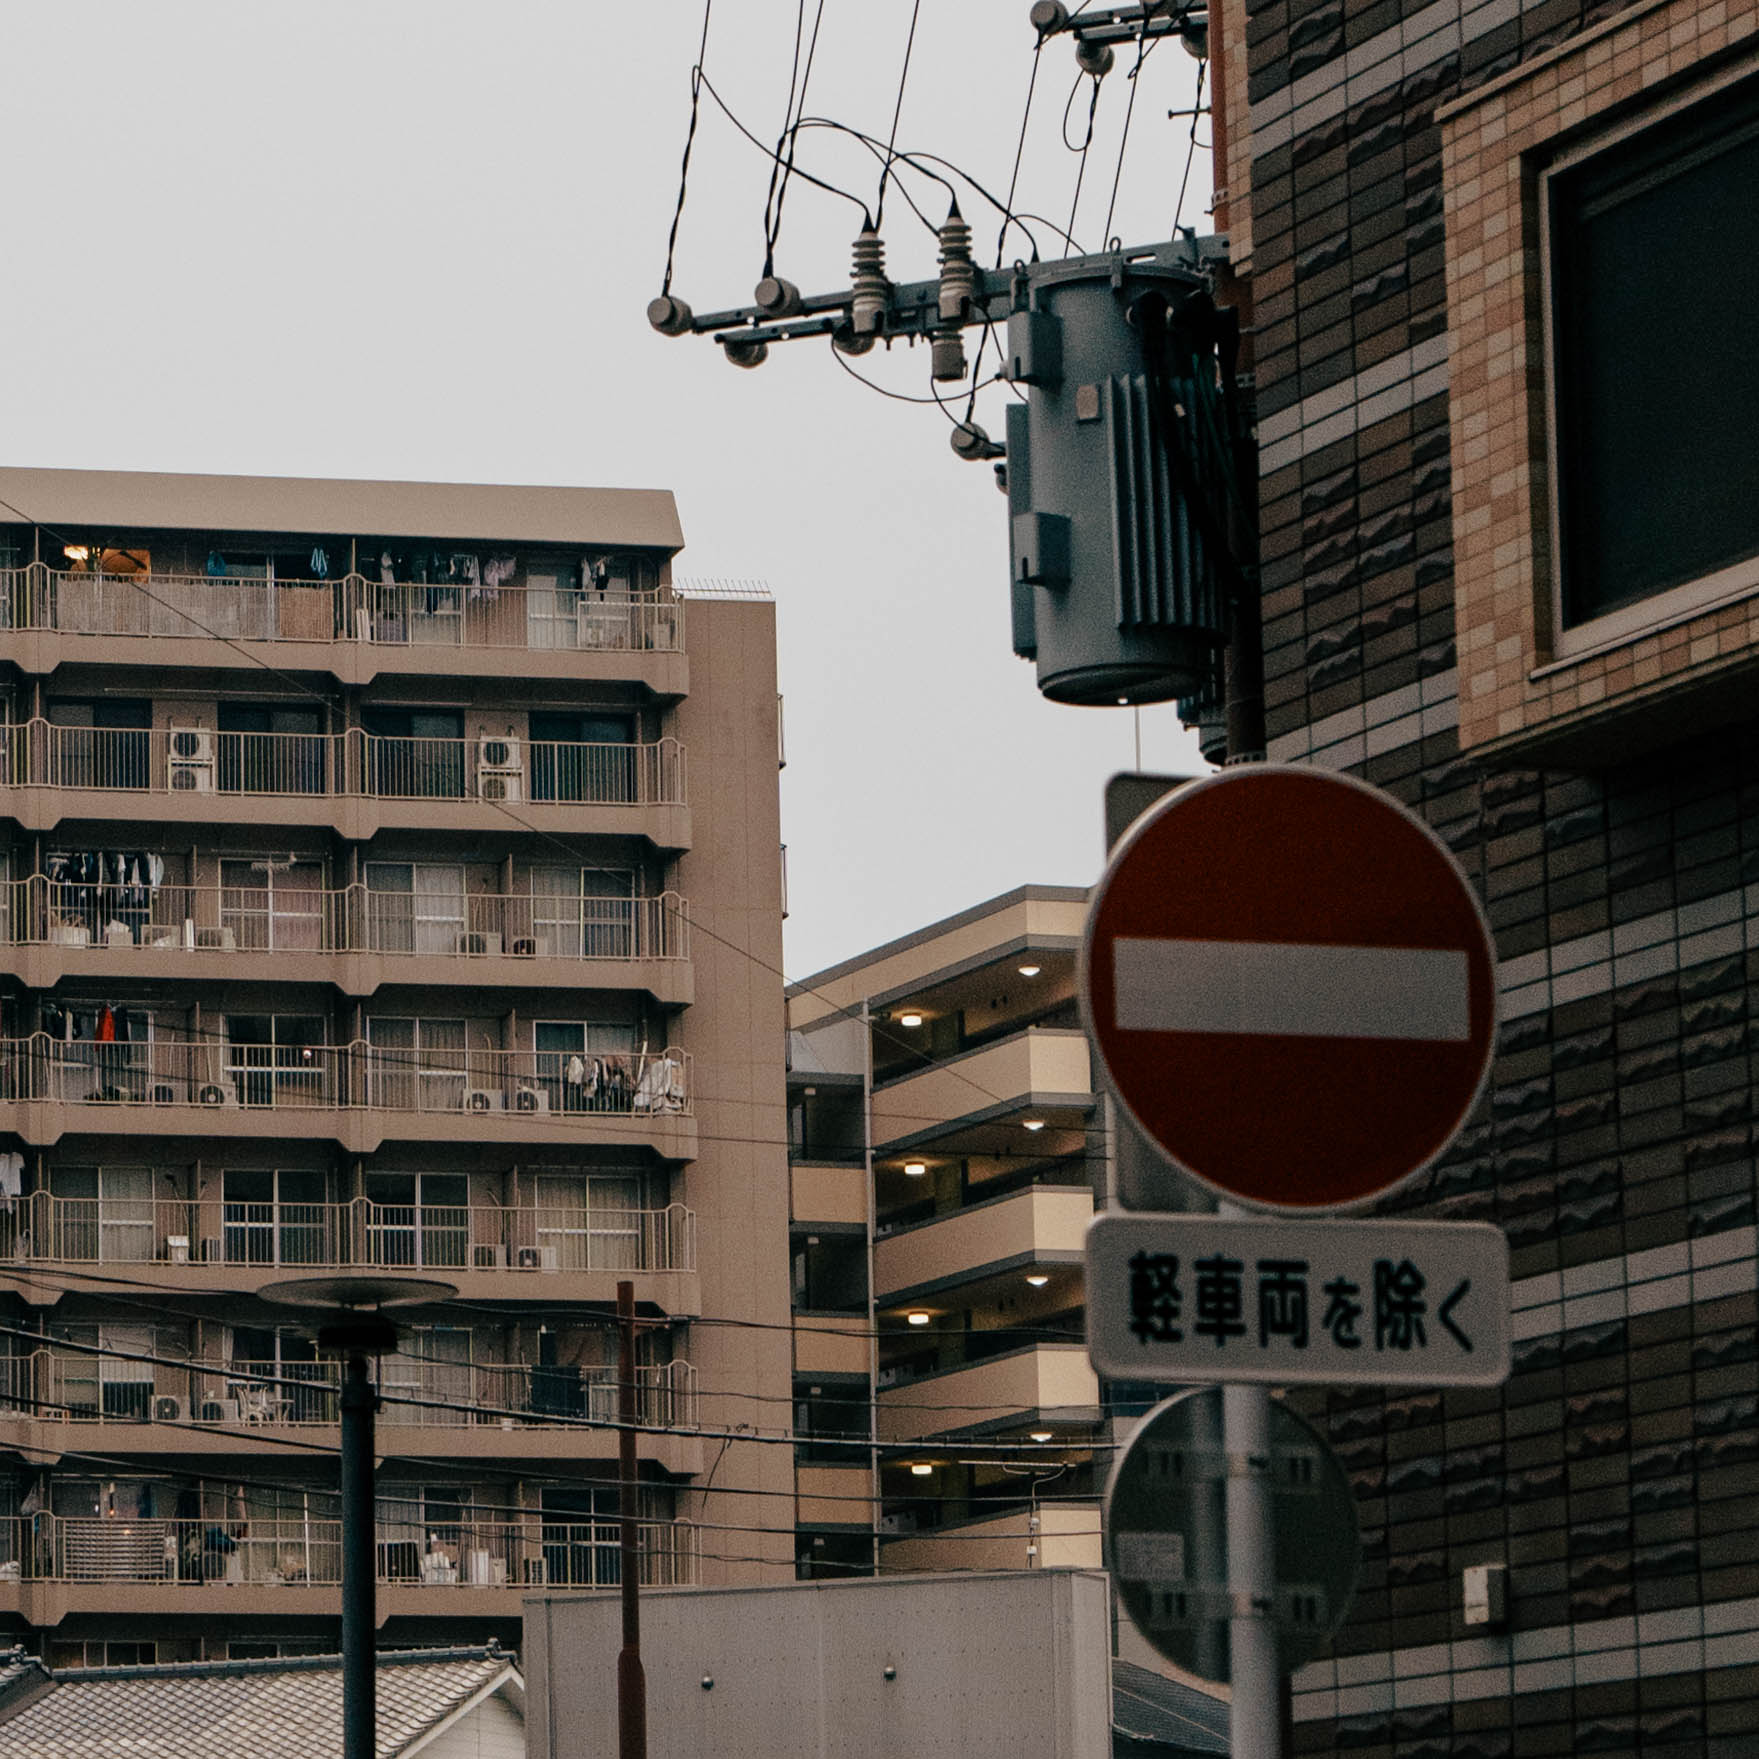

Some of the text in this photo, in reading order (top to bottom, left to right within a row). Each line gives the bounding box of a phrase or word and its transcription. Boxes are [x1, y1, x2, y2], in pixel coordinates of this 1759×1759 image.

[1128, 1250, 1475, 1352] 軽車両を除く
